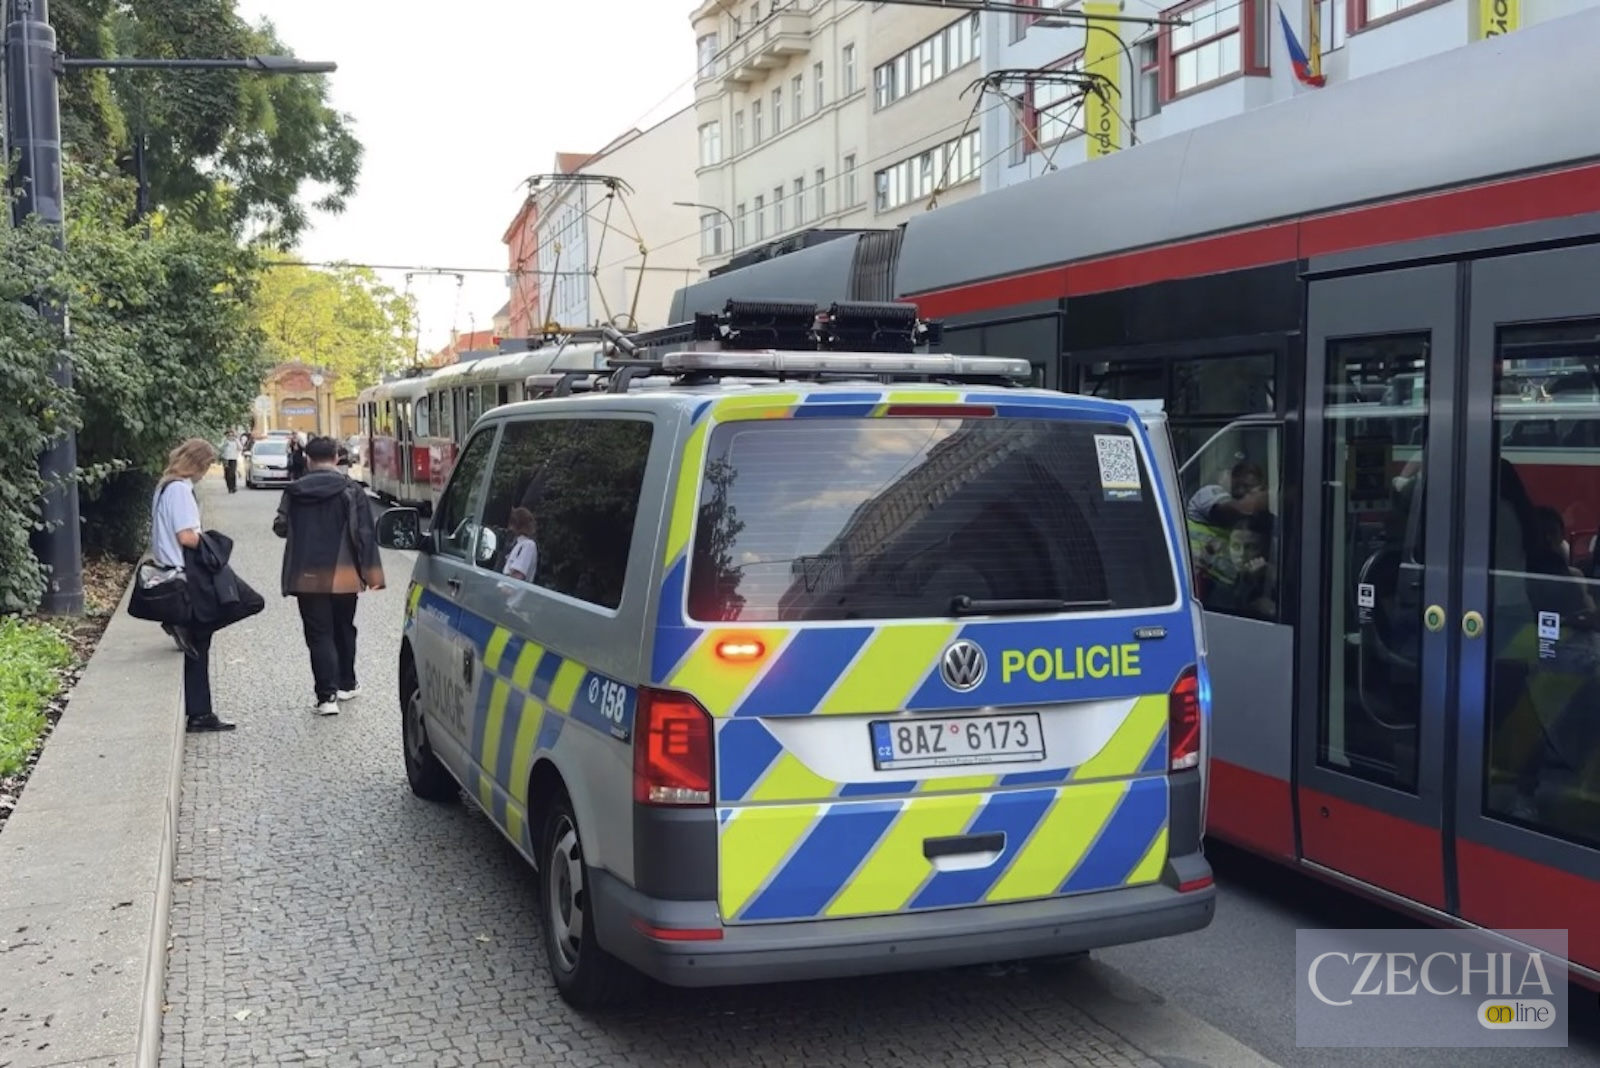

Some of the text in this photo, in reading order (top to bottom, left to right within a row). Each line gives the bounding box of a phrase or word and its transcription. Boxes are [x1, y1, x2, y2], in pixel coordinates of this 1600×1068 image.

[1002, 643, 1141, 683] POLICIE
[600, 680, 626, 723] 158
[878, 747, 892, 756] CZ
[897, 720, 1028, 754] 8AZ 6173
